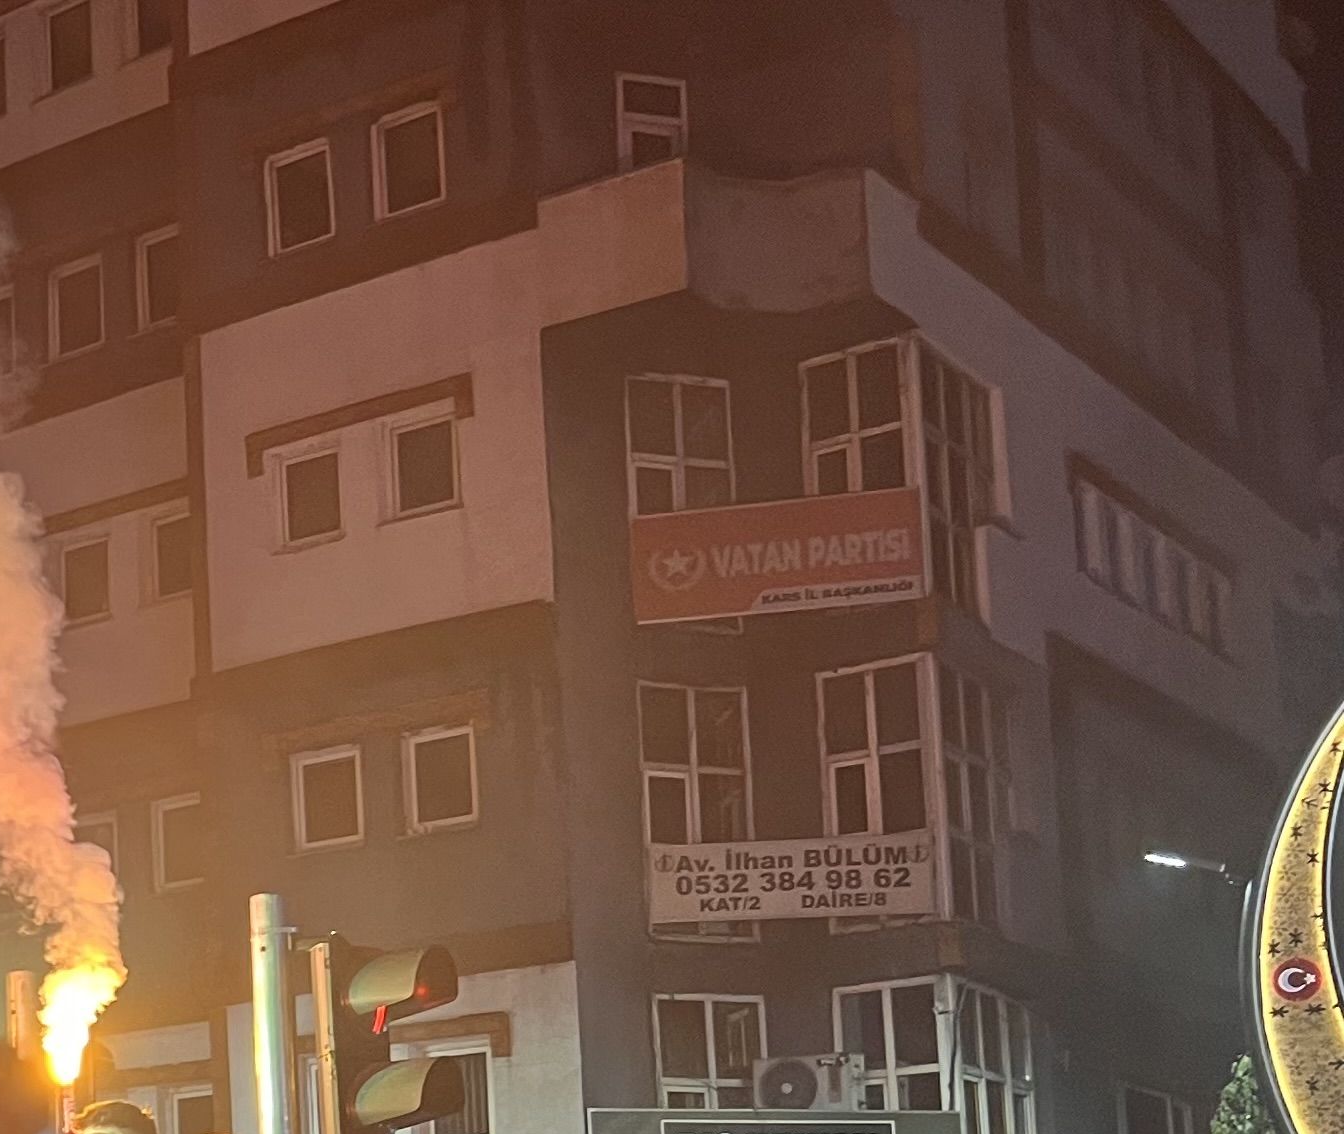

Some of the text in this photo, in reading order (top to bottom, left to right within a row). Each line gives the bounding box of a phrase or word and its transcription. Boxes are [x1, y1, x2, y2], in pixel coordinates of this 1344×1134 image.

[714, 538, 801, 578] VATAN
[762, 592, 801, 604] KARS
[805, 587, 818, 600] İL
[675, 844, 908, 873] Av. İlhan BÜLÜM
[675, 867, 912, 896] 0532 384 98 62
[699, 890, 887, 912] KAT/2 DAİRE/8
